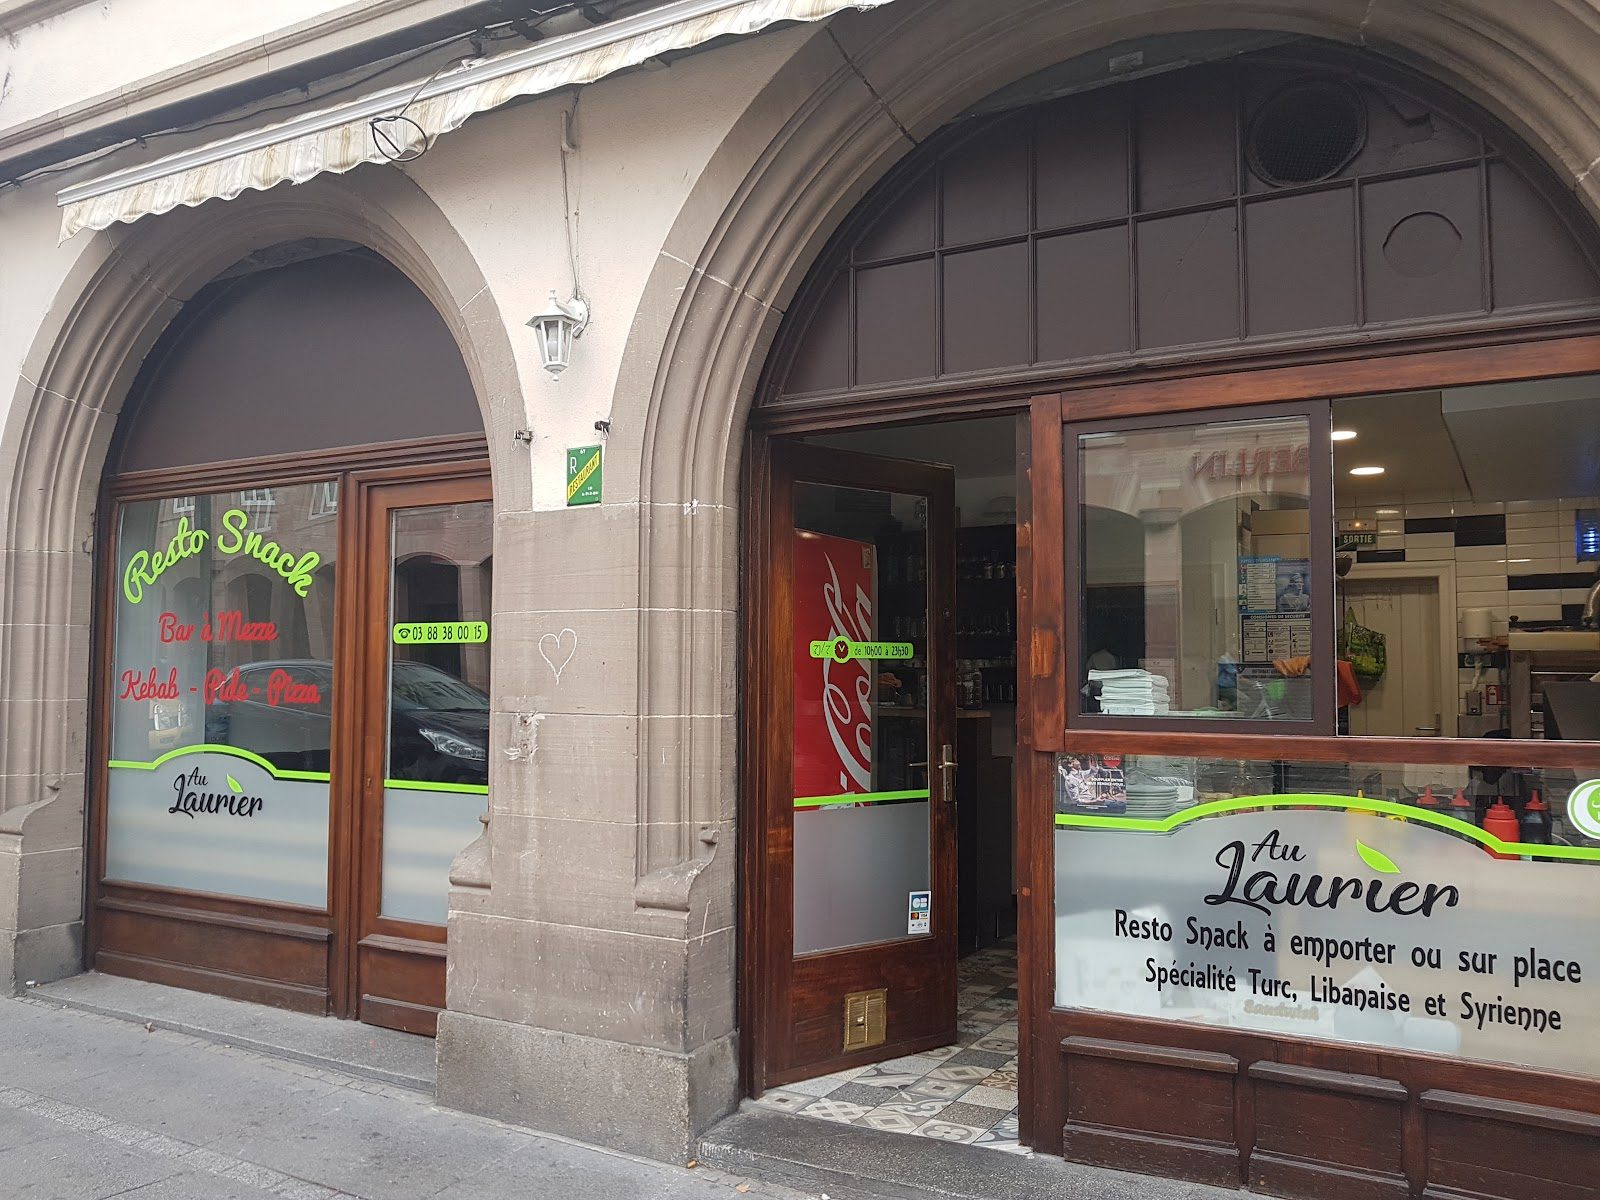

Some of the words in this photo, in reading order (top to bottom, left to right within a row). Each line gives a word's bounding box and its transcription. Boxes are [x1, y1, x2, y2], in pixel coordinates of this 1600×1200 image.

[568, 453, 599, 497] RESTAURANT
[570, 456, 577, 475] R
[124, 516, 209, 603] Resto
[218, 509, 320, 597] Snack
[1343, 535, 1372, 543] SORTIE
[159, 613, 195, 643] Bar
[200, 611, 213, 641] à
[217, 610, 279, 643] Mezze
[413, 627, 422, 640] 03
[428, 626, 437, 640] 88
[443, 626, 452, 639] 38
[458, 625, 468, 639] 00
[474, 625, 482, 639] 15
[855, 646, 861, 655] de
[864, 646, 882, 657] 10h00
[885, 646, 888, 655] à
[892, 646, 909, 657] 23h30
[120, 667, 179, 701] Kebab
[204, 668, 249, 705] Pide
[267, 669, 320, 706] Pizza
[188, 766, 208, 787] Au
[169, 773, 263, 819] Laurier
[1251, 829, 1306, 862] Au
[1203, 840, 1459, 917] Laurier
[1115, 908, 1173, 943] Resto
[1186, 915, 1249, 952] Snack
[1264, 924, 1276, 953] à
[1290, 935, 1396, 968] emporter
[1411, 946, 1441, 969] ou
[1458, 951, 1498, 976] sur
[1513, 946, 1582, 988] place
[1145, 957, 1237, 993] Spécialité
[1247, 968, 1299, 1003] Turc,
[1310, 975, 1410, 1013] Libanaise
[1425, 993, 1447, 1017] et
[1460, 992, 1562, 1033] Syrienne
